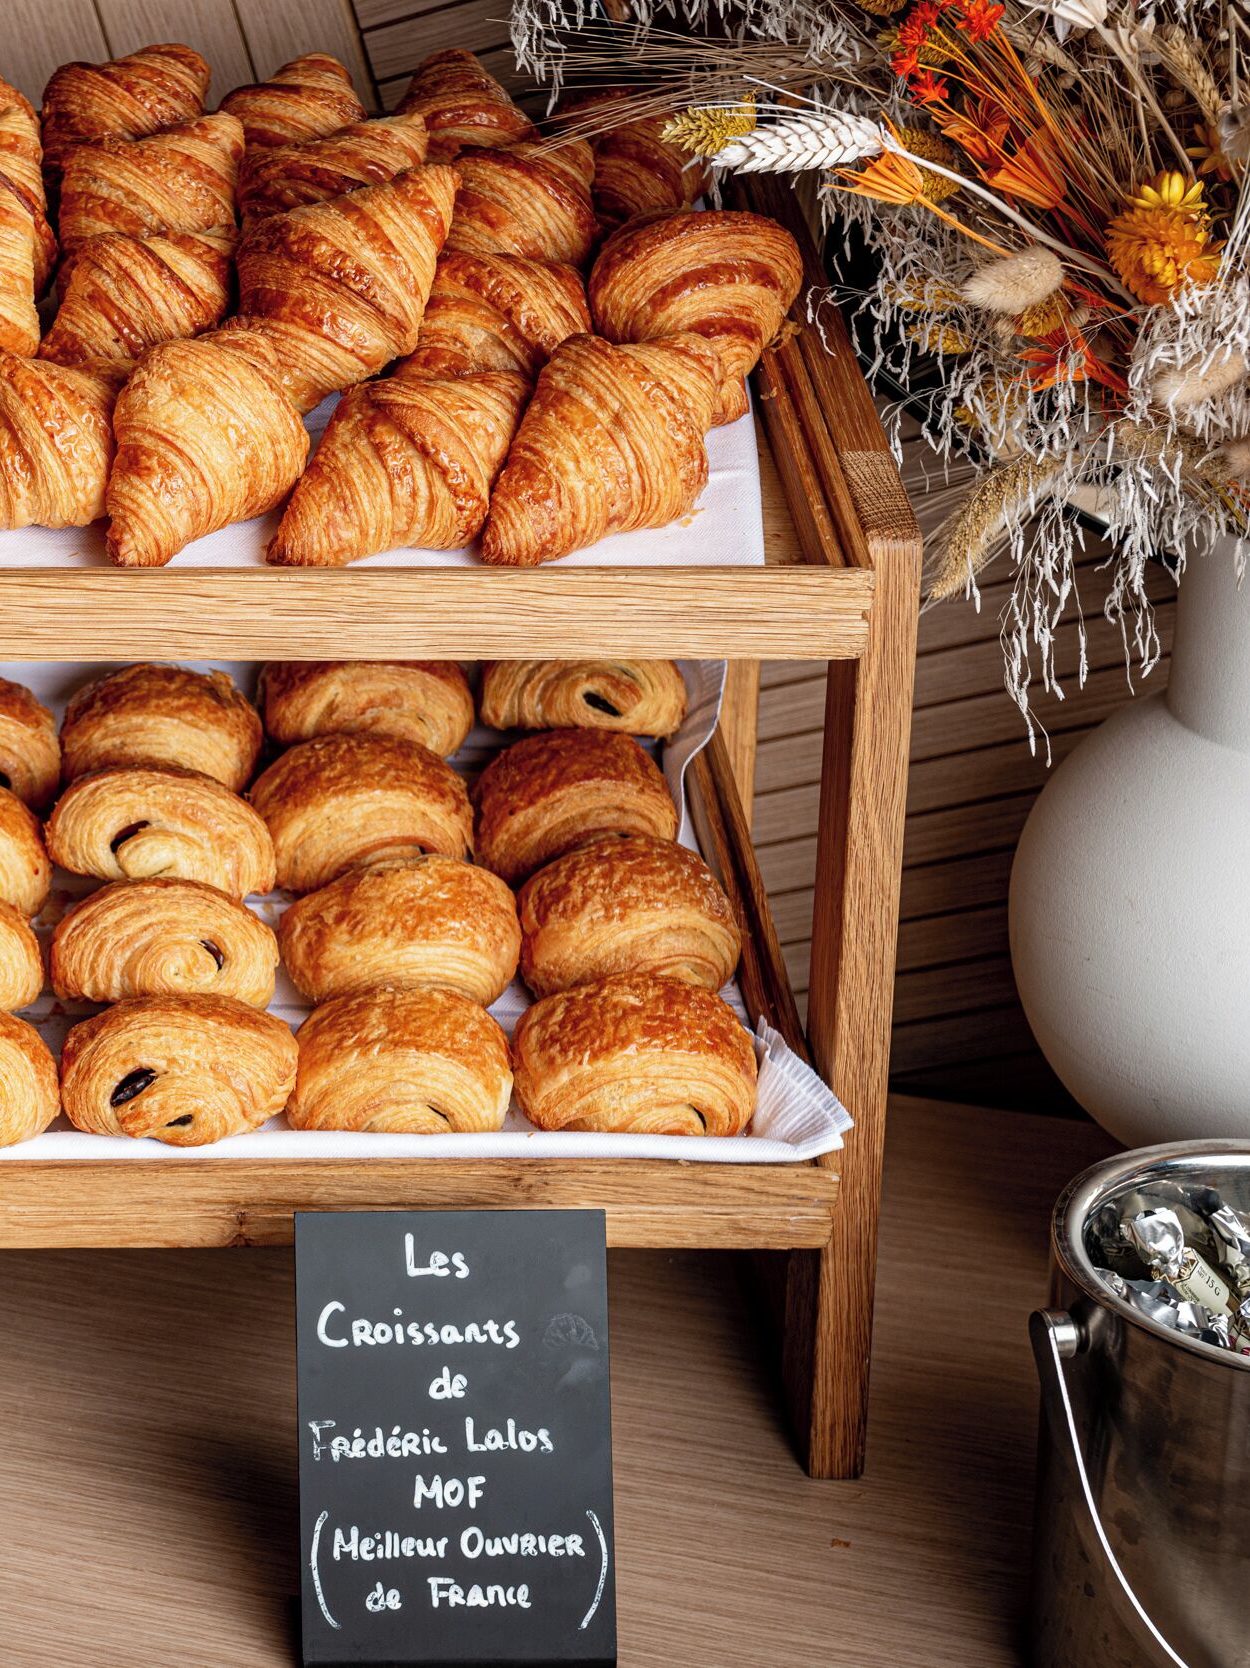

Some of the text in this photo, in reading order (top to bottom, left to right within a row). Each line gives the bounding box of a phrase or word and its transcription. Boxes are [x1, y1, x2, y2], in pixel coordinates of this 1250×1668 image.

[405, 1232, 471, 1280] Les
[1205, 1275, 1221, 1296] 15 G
[428, 1365, 469, 1401] de
[464, 1416, 554, 1454] Lalos
[413, 1474, 488, 1509] MOF
[365, 1581, 403, 1613] de
